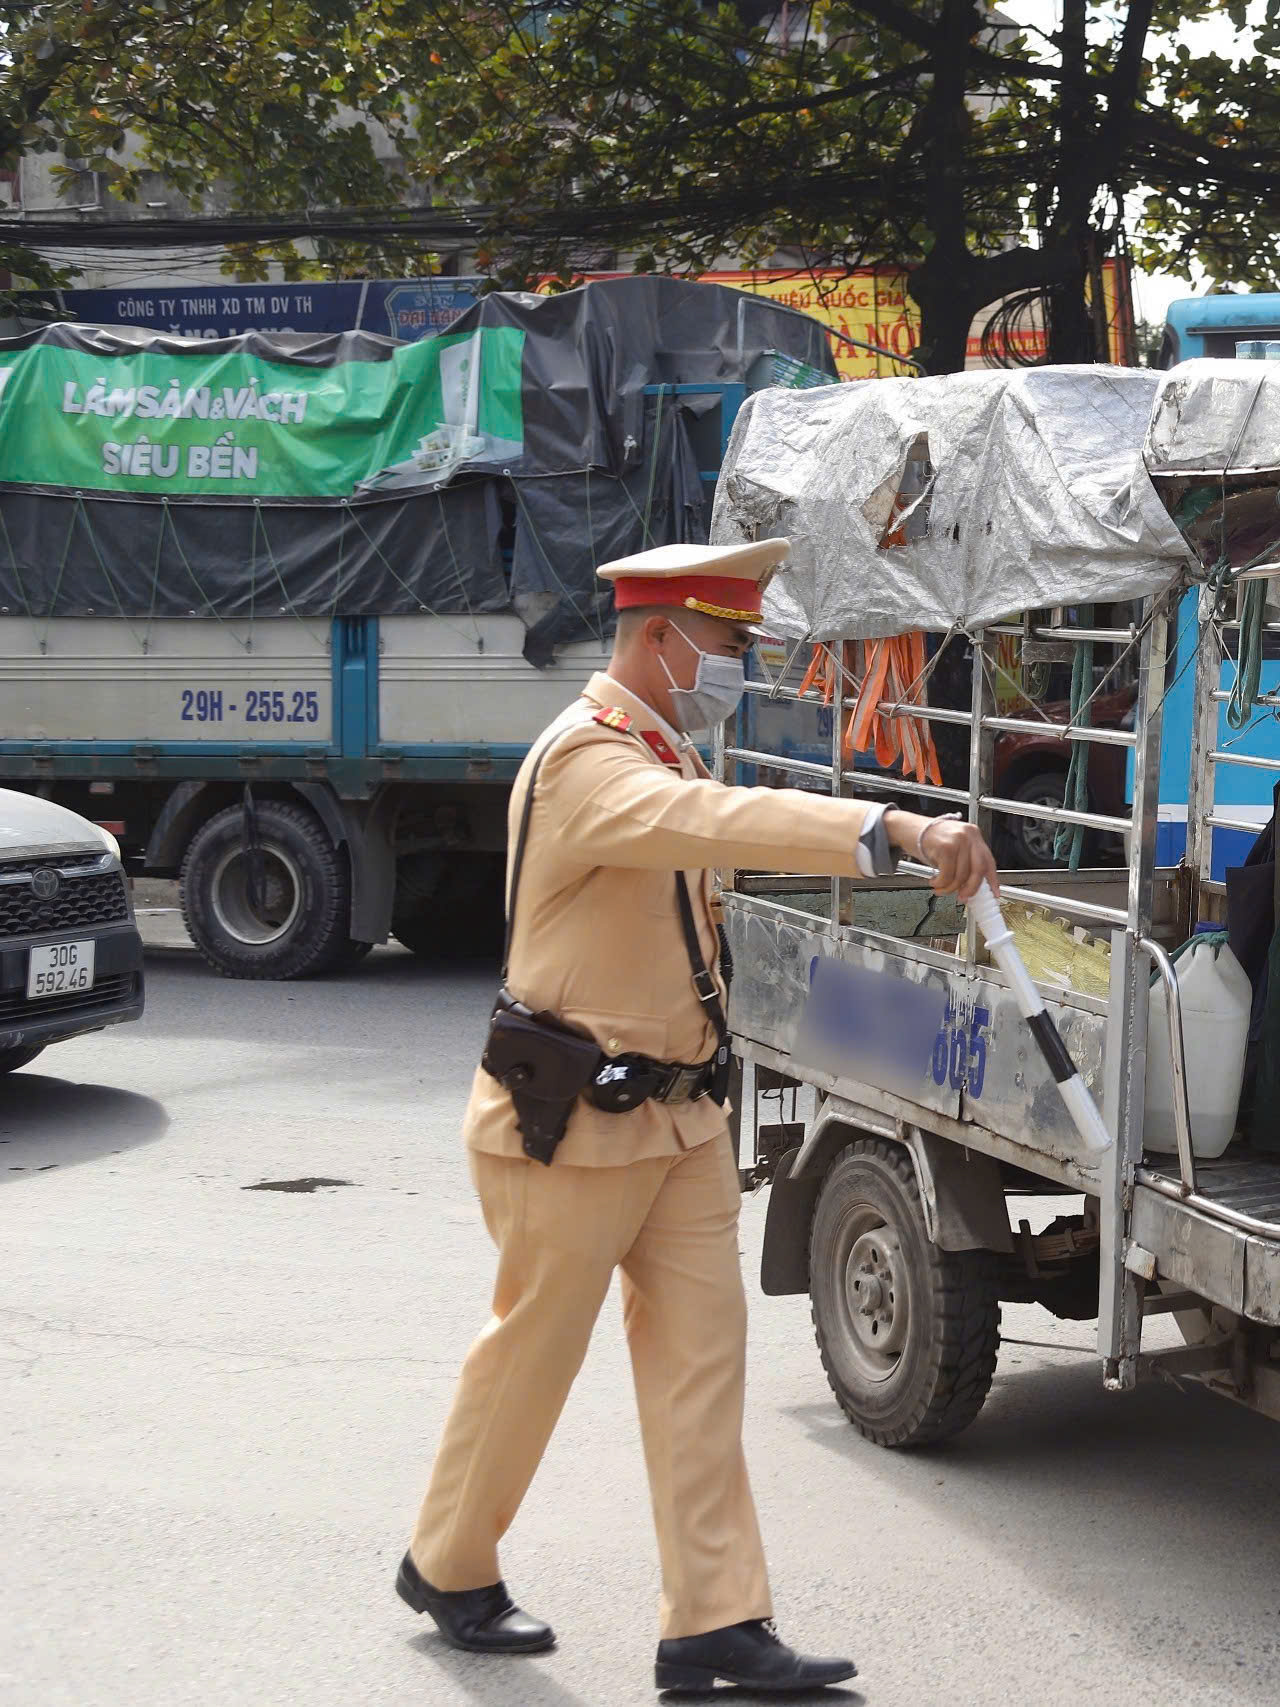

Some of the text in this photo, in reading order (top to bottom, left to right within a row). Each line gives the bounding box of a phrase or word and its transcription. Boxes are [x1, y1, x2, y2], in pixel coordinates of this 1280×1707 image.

[117, 296, 313, 318] CÔNG TY TNHH XD TM DV TH
[816, 284, 869, 309] QUỐC
[875, 290, 905, 307] GIA
[102, 430, 259, 479] SIÊU BỀN
[181, 690, 223, 722] 29H
[245, 690, 319, 722] 255.25
[49, 945, 78, 968] 30G
[35, 967, 88, 994] 592.46
